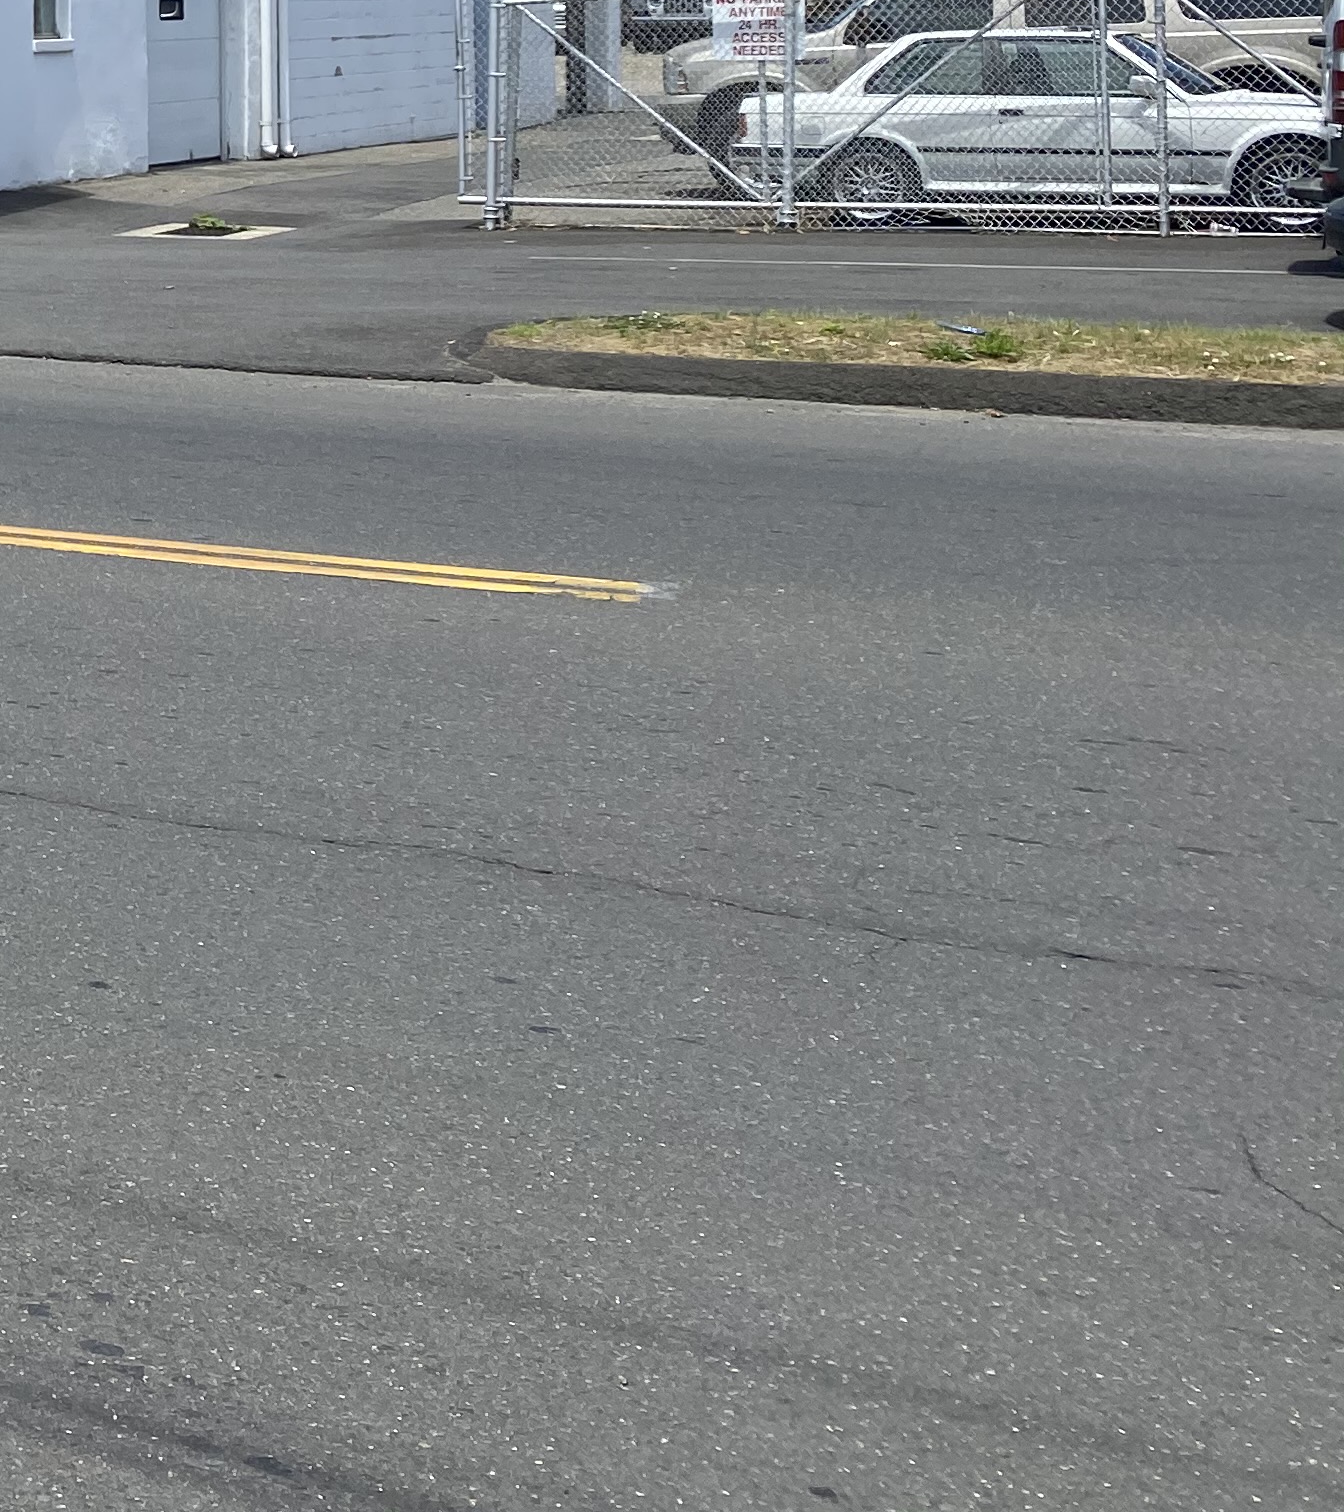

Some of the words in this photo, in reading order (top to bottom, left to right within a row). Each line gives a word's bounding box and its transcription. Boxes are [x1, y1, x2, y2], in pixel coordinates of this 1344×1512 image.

[738, 19, 753, 30] 24
[732, 31, 786, 44] ACCESS
[732, 44, 786, 56] NEEDED
